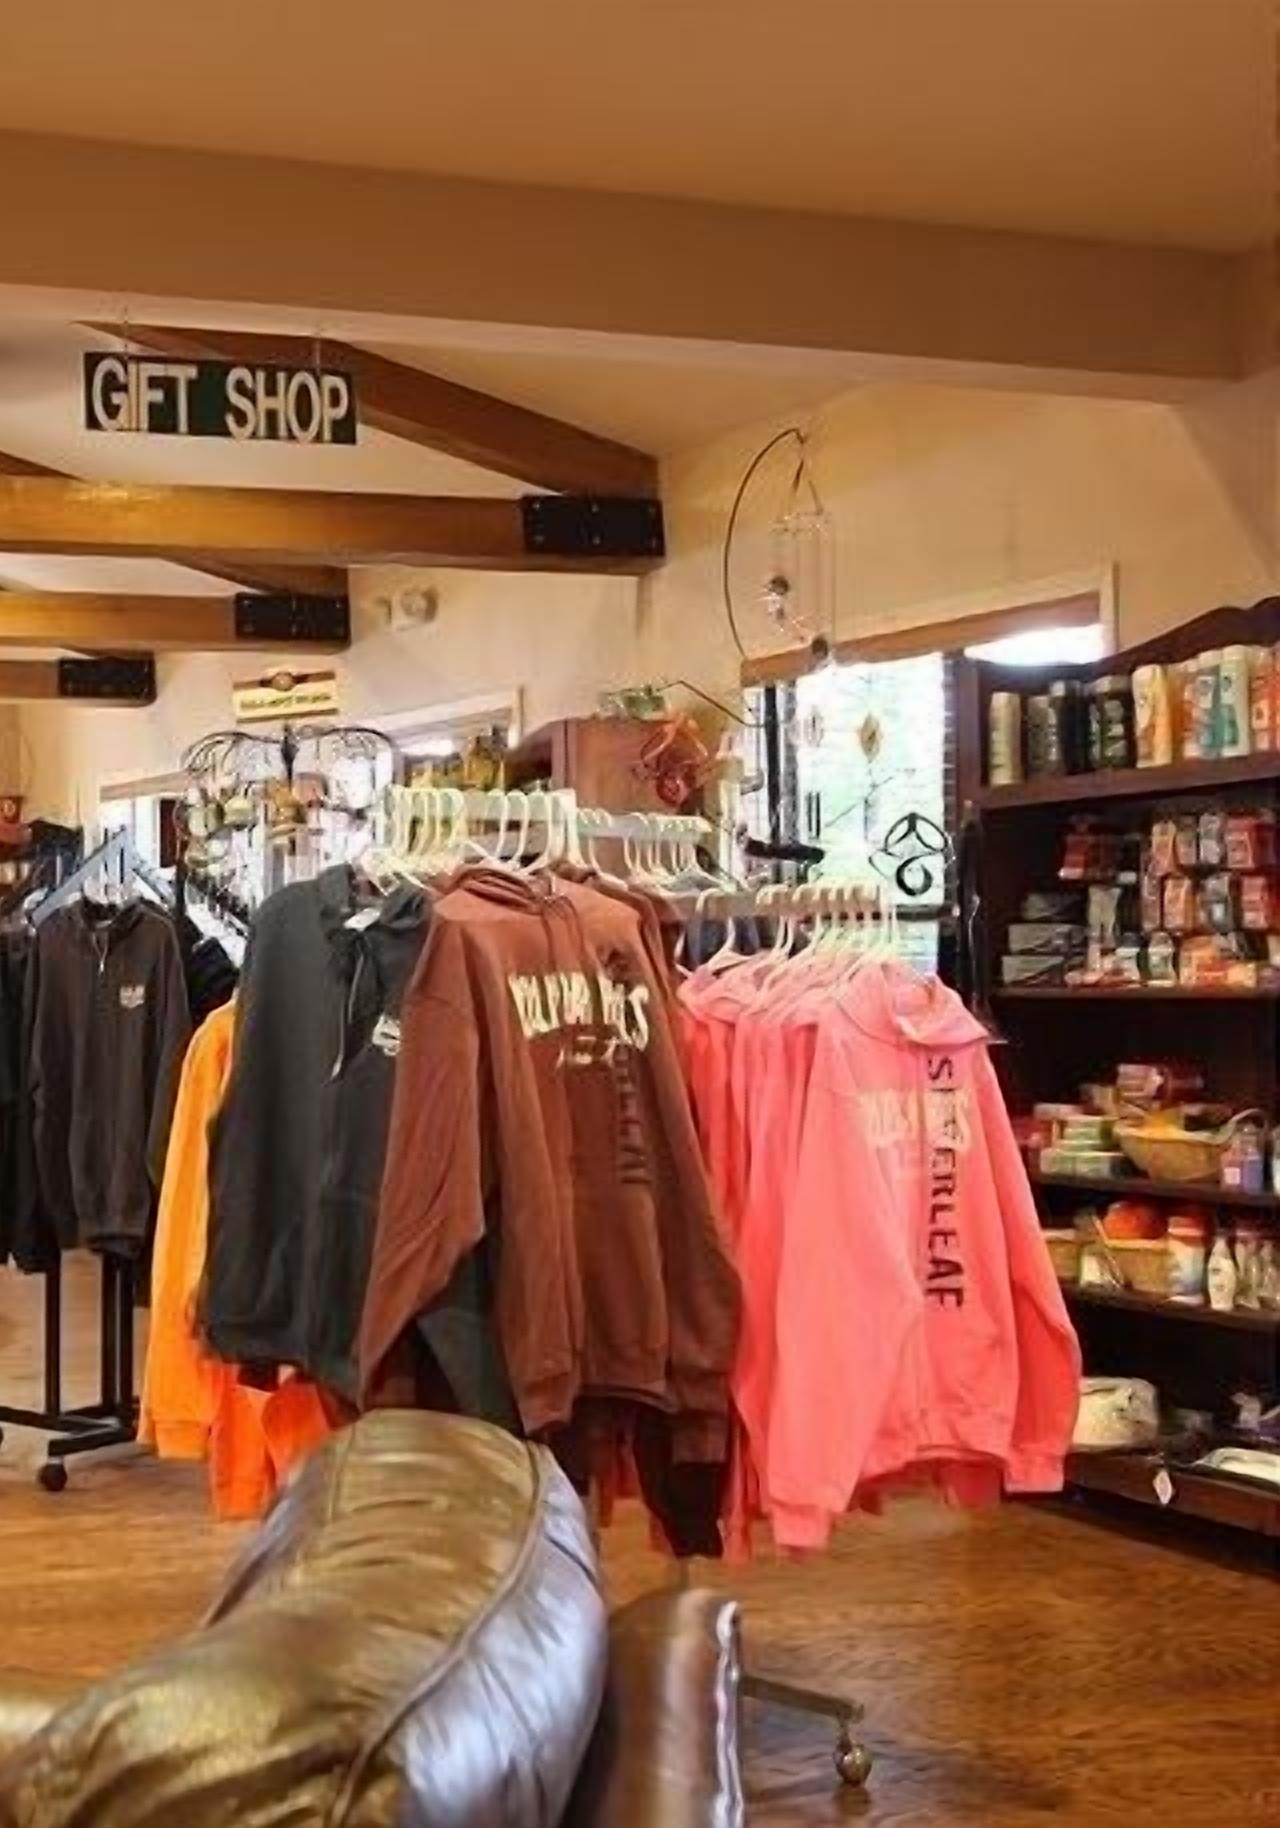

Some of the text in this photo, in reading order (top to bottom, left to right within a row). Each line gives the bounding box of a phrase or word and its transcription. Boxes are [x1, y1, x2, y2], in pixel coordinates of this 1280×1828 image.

[92, 357, 348, 443] GIFT SHOP
[924, 1055, 964, 1308] SIVERLEAF
